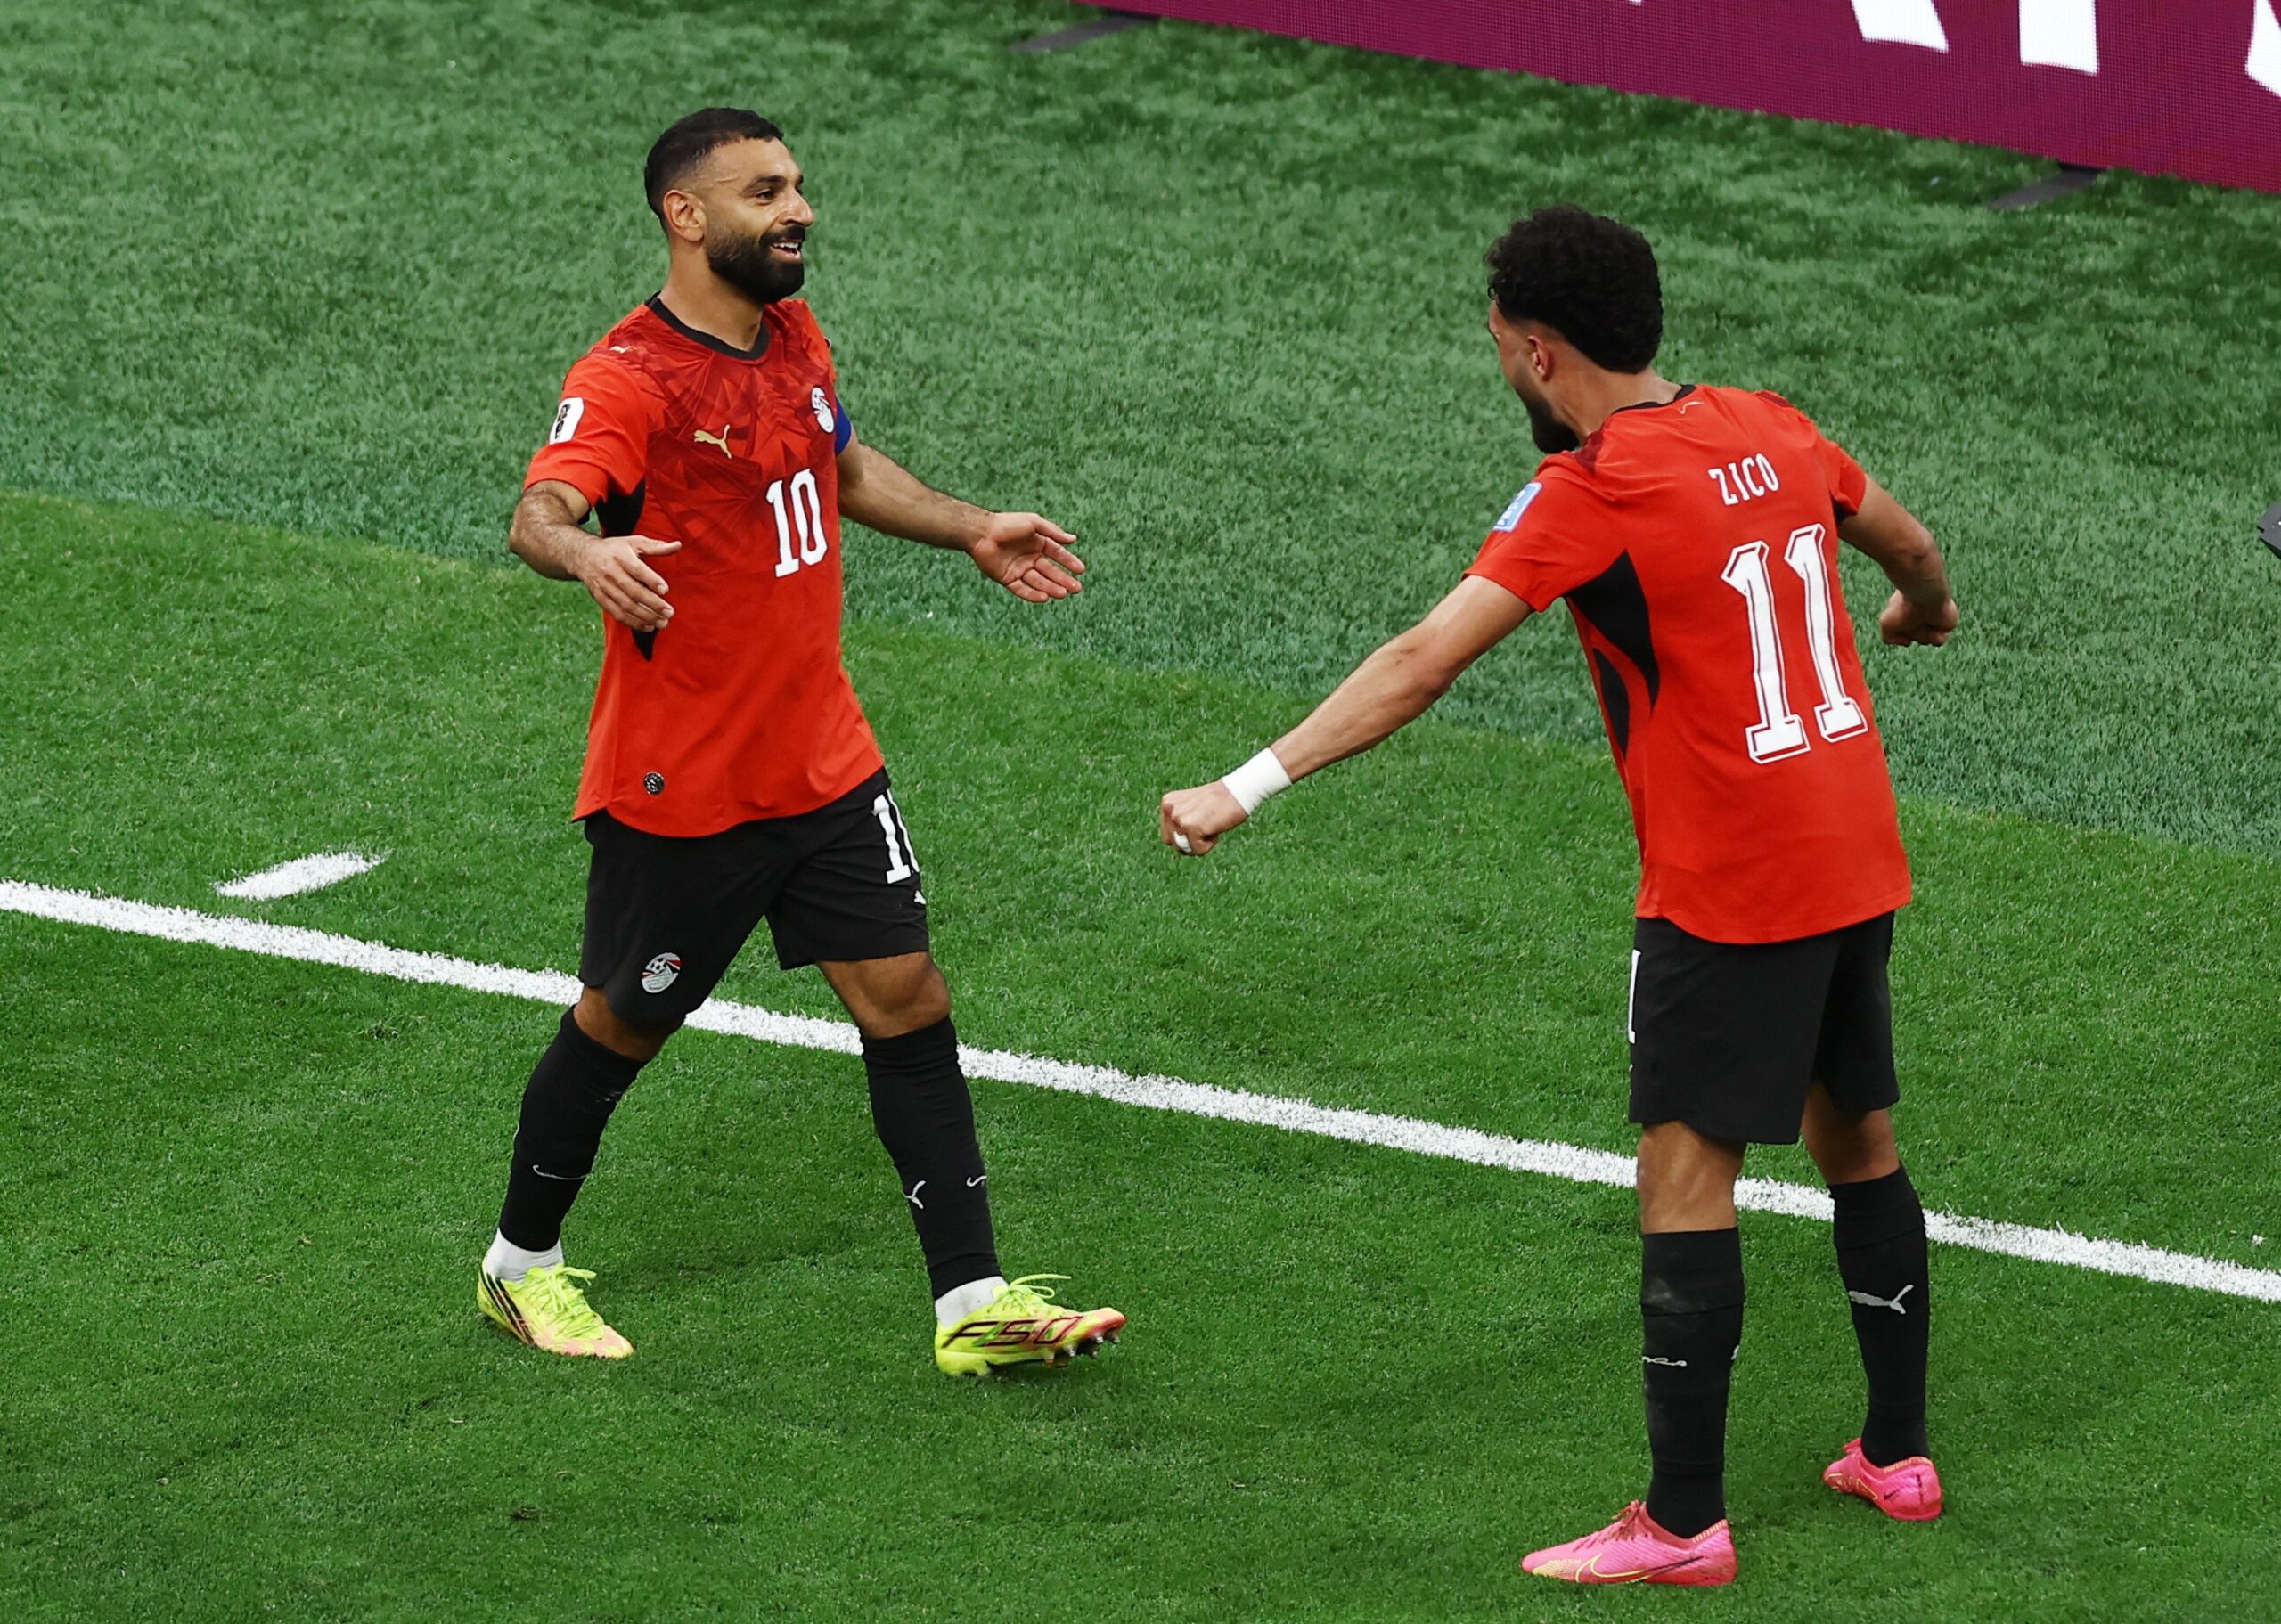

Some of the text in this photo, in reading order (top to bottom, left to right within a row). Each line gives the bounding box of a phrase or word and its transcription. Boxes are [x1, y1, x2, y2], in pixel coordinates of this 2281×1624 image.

[1707, 453, 1779, 506] ZICO
[765, 468, 828, 578] 10
[1721, 523, 1868, 763] 11
[941, 1316, 1083, 1348] F50
